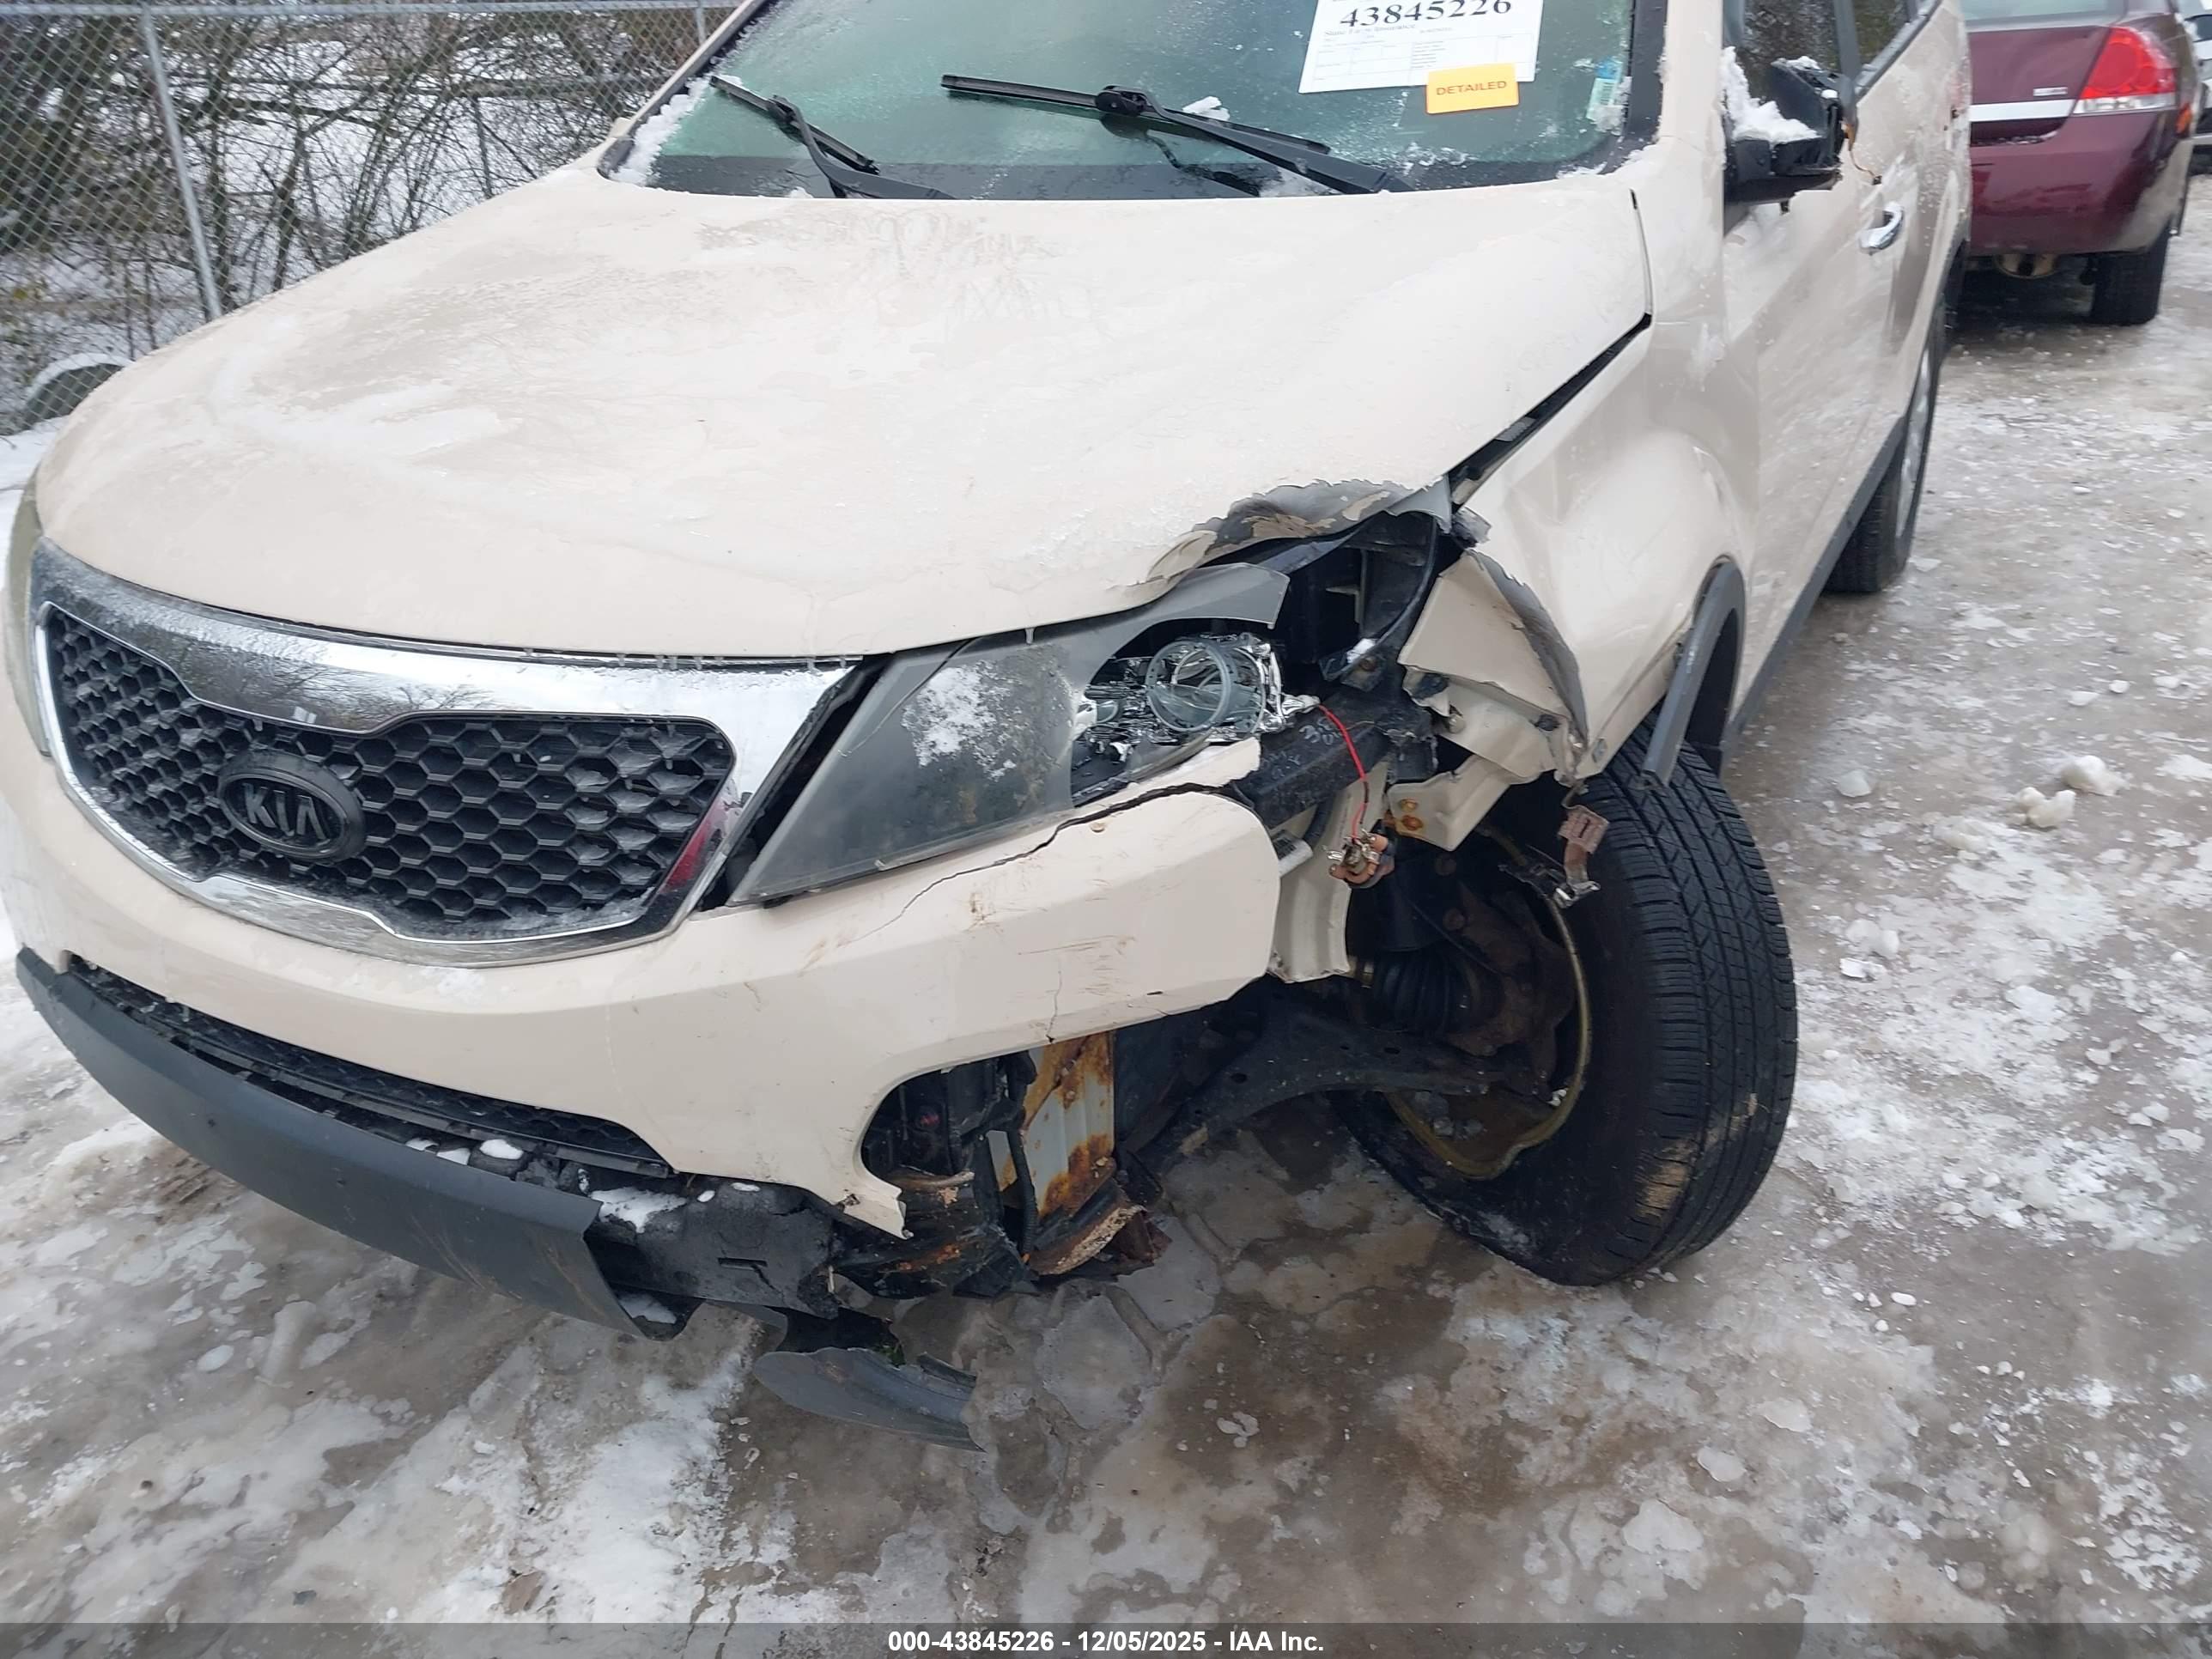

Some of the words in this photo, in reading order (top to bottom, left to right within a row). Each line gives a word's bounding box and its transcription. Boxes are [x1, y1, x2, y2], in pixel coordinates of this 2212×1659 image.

[1340, 0, 1511, 27] 43845226
[1436, 81, 1507, 95] DETAILED
[242, 782, 327, 841] KIA
